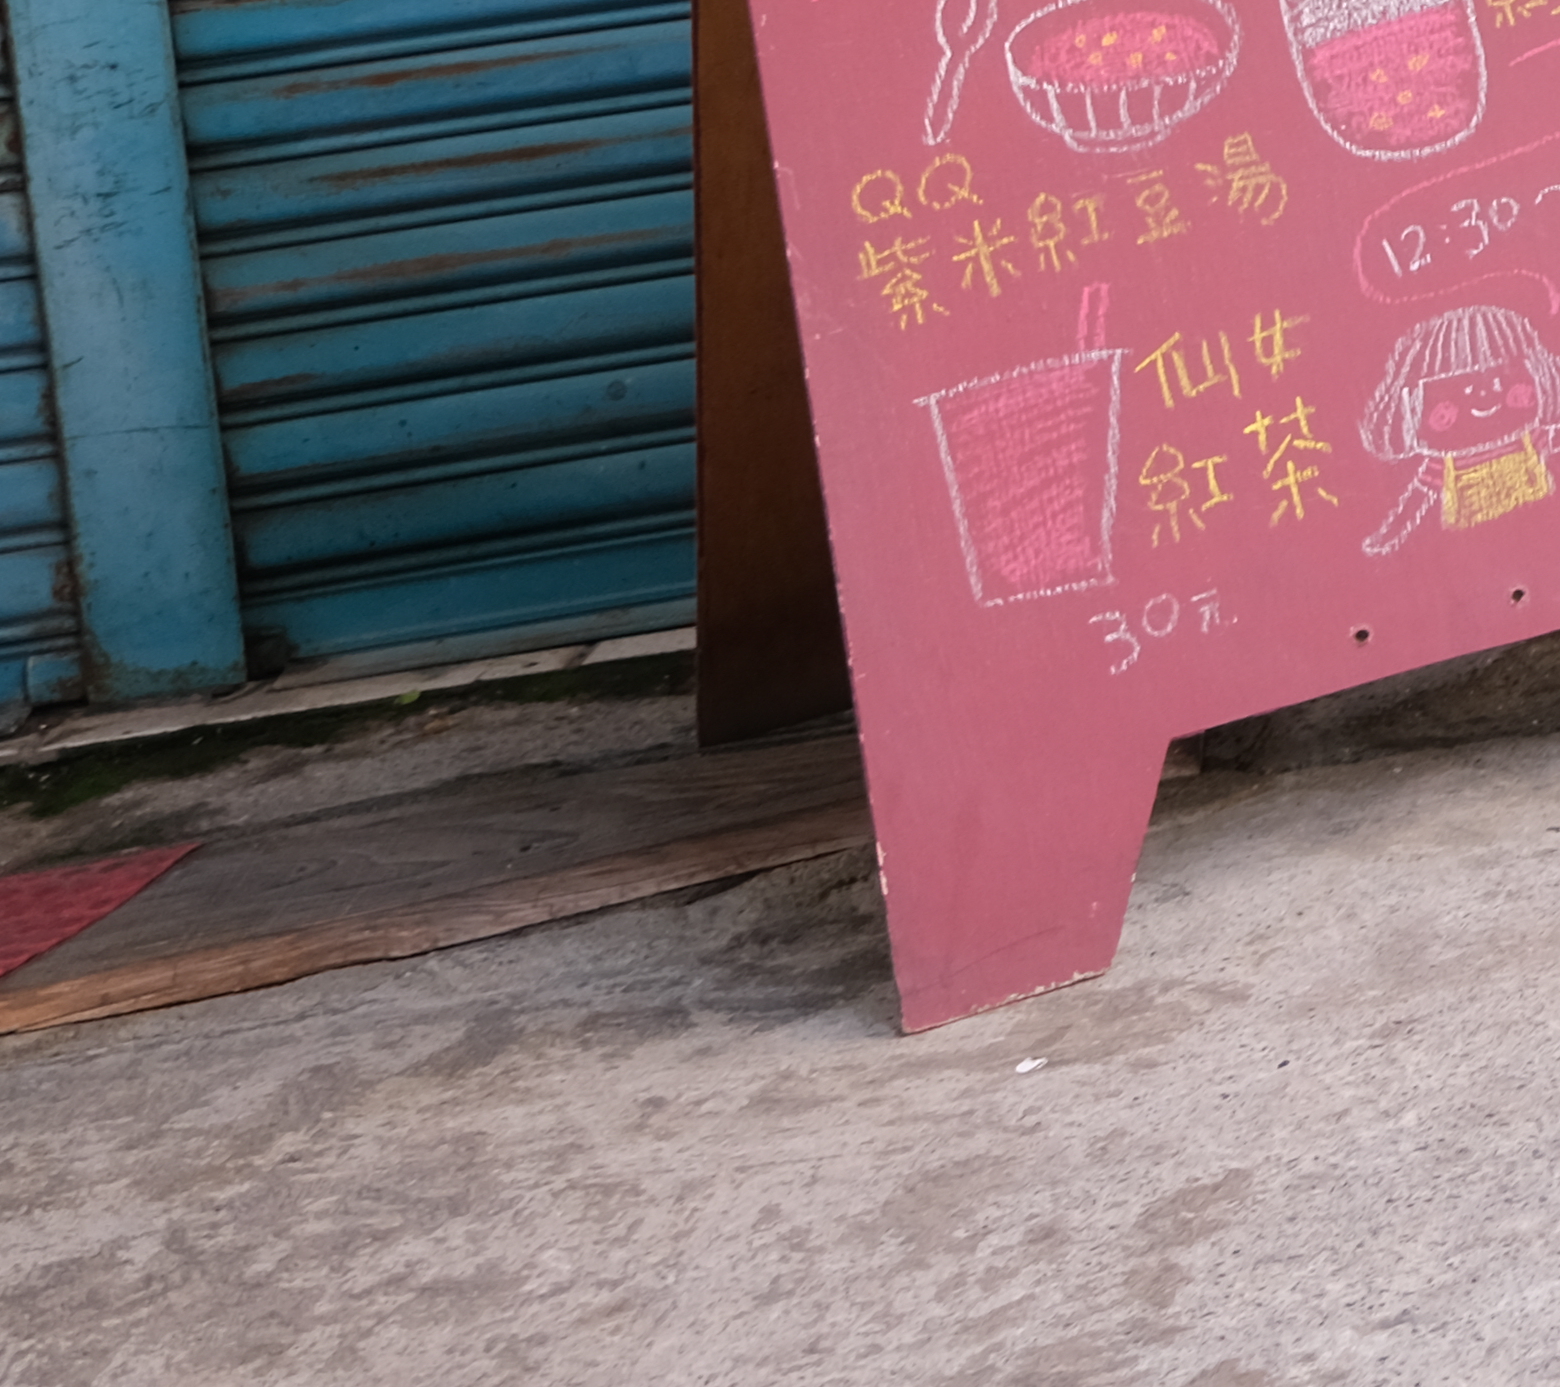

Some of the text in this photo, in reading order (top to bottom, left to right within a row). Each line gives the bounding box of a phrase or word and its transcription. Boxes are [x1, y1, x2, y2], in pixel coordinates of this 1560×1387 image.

[851, 153, 985, 223] QQ
[857, 132, 1289, 331] 紫米紅豆湯
[1134, 308, 1312, 409] 仙女
[1138, 396, 1340, 550] 紅茶
[1088, 587, 1240, 675] 30元
